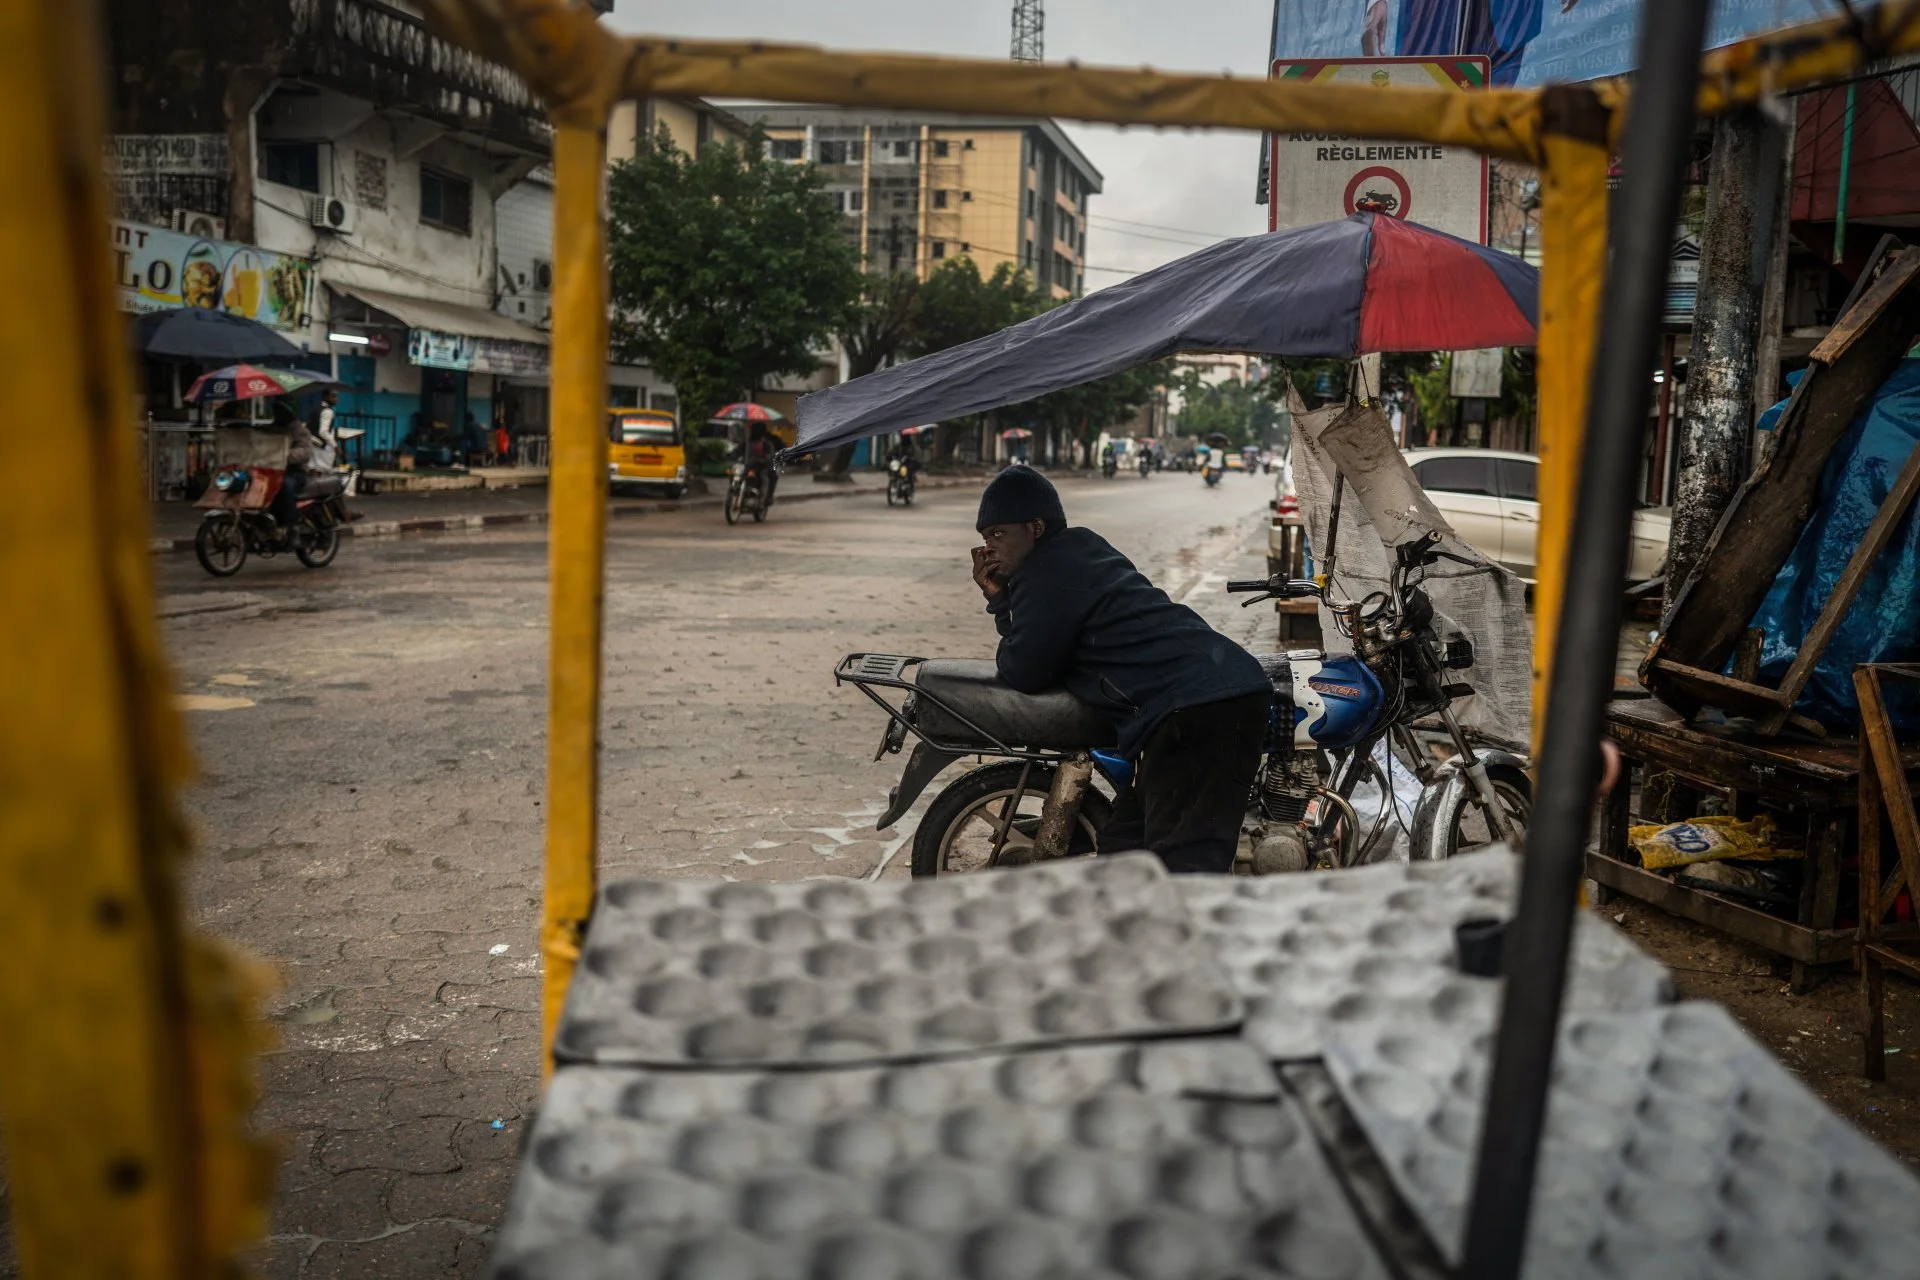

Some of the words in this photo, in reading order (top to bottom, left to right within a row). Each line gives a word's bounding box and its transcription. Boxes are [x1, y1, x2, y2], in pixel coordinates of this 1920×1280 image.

[1551, 10, 1580, 26] THE
[1584, 1, 1621, 19] WISE
[1545, 60, 1572, 77] THE
[1577, 51, 1612, 71] WISE
[1316, 144, 1443, 161] RÈGLEMENTE
